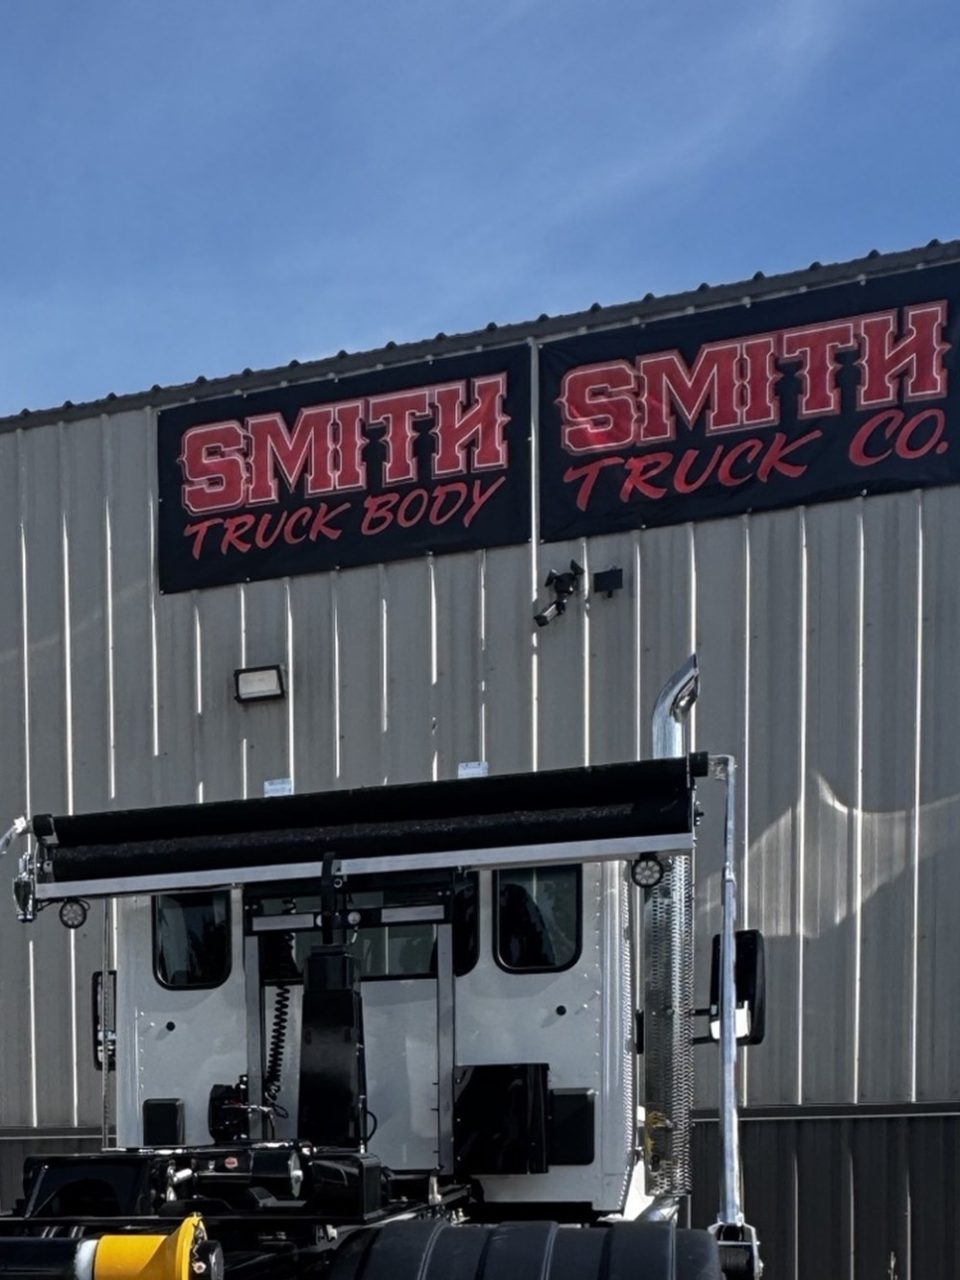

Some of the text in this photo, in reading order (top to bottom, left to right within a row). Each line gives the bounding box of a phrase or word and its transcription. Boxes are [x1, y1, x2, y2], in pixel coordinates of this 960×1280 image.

[555, 301, 952, 454] SMITH
[178, 372, 512, 517] SMITH
[563, 407, 949, 511] TRUCK CO.
[184, 475, 507, 560] TRUCK BODY
